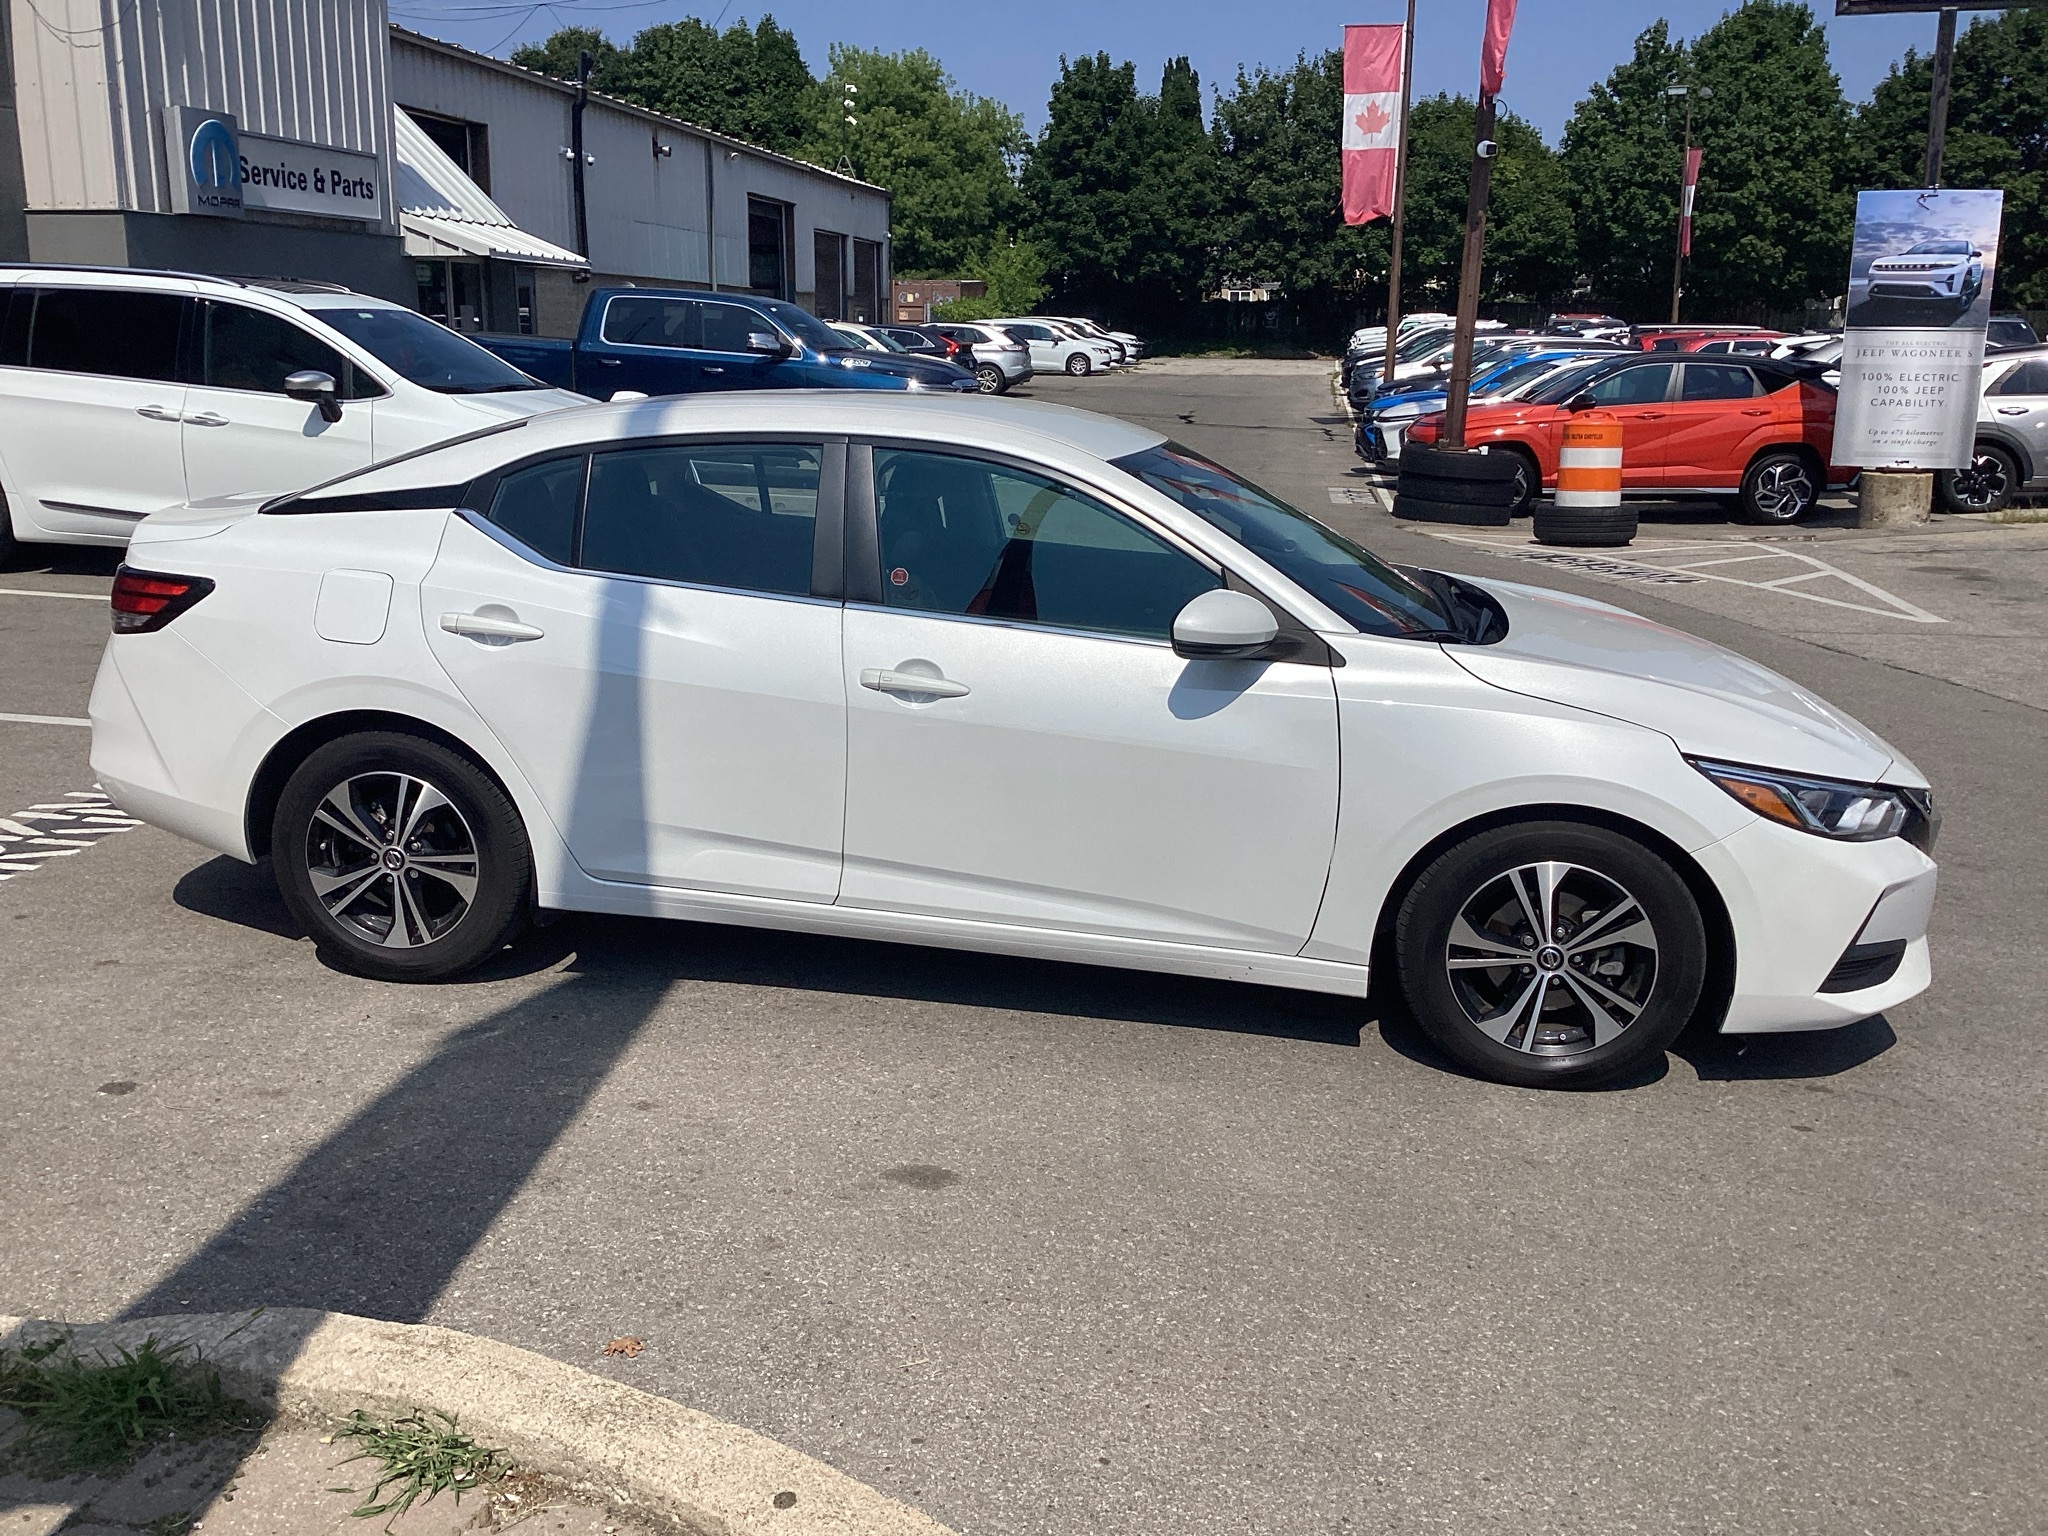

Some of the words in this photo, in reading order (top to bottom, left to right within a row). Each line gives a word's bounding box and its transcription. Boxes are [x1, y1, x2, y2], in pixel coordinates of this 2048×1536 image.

[239, 155, 308, 191] Service
[313, 167, 325, 193] &
[330, 170, 374, 200] Parts
[197, 194, 241, 209] MOPAR
[1855, 348, 1885, 359] JEEP
[1891, 349, 1962, 358] WAGONEER
[1967, 350, 1973, 358] S
[1861, 372, 1893, 382] 100%
[1899, 373, 1962, 382] ELECTRIC.
[1877, 385, 1909, 395] 100%
[1914, 386, 1945, 395] JEEP
[1868, 428, 1879, 436] Up
[1890, 437, 1913, 446] single
[1913, 438, 1938, 447] charge
